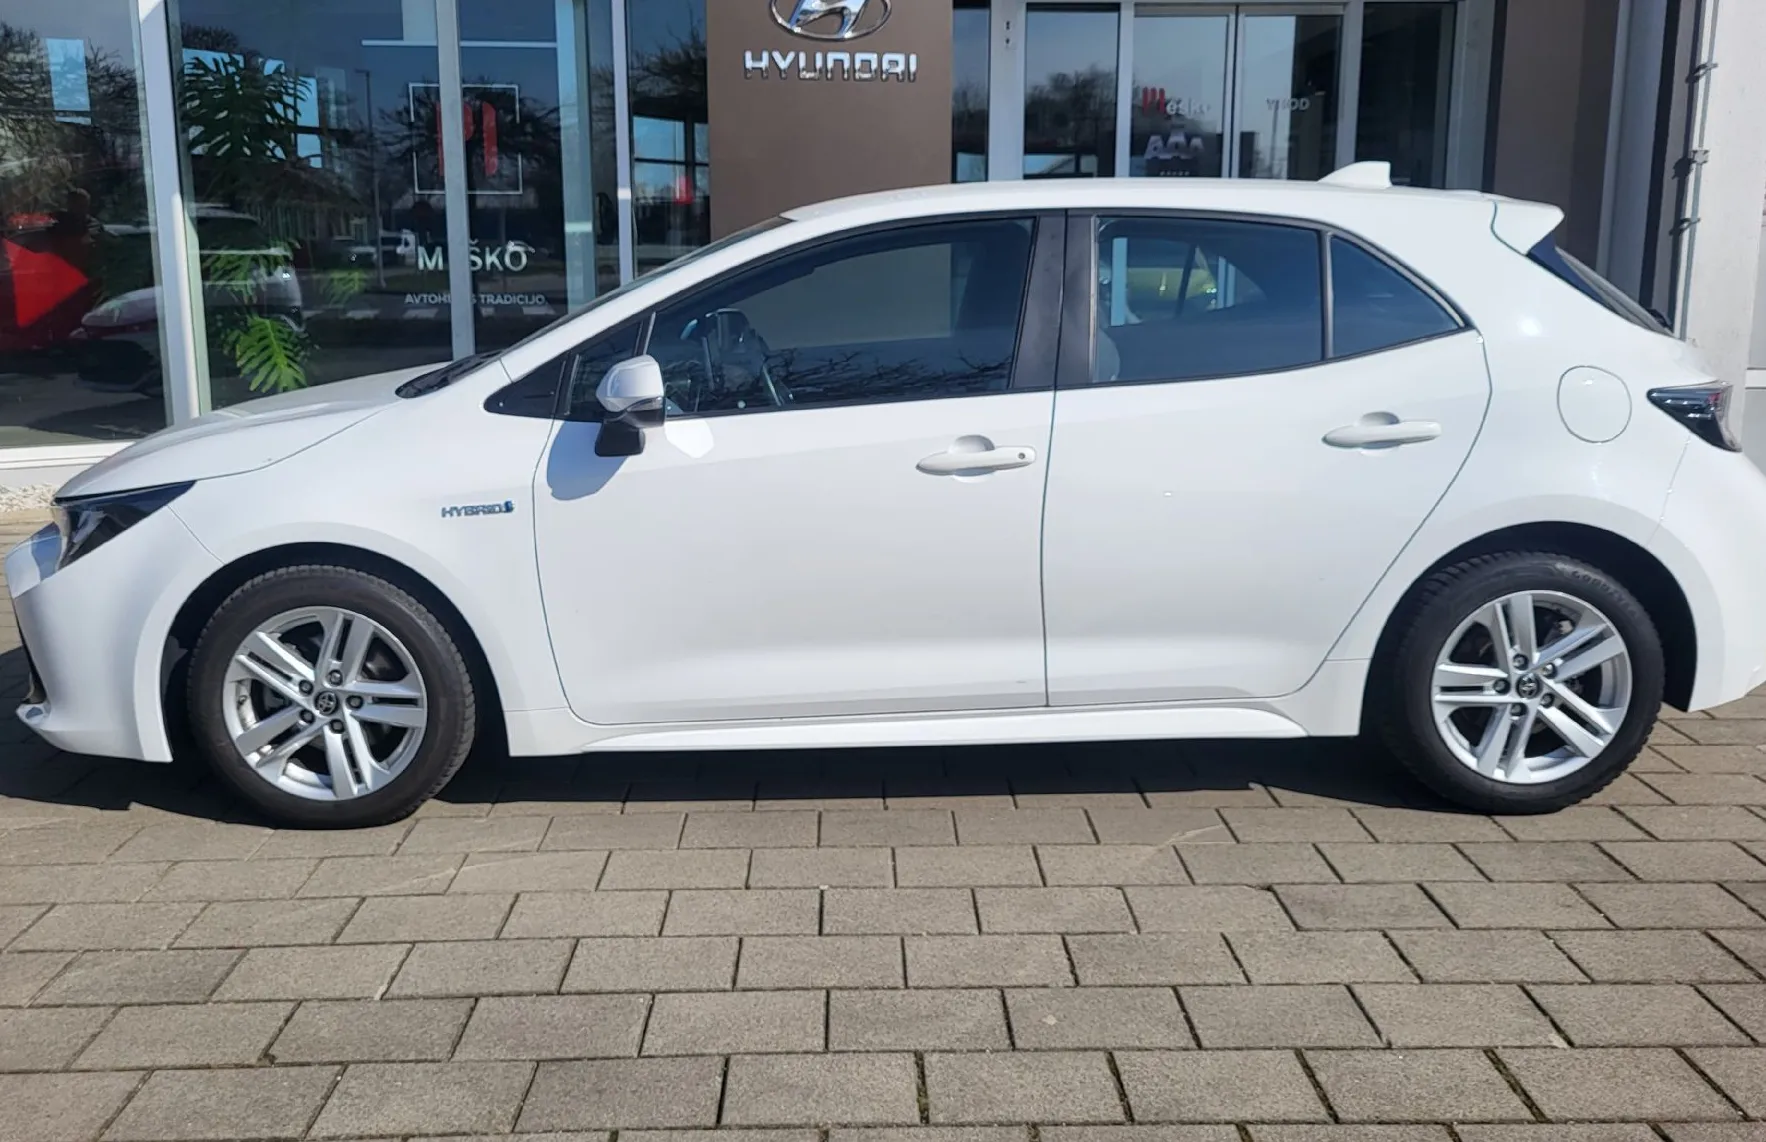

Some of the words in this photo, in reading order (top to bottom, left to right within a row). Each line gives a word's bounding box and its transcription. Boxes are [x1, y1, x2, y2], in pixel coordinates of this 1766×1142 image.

[744, 50, 918, 82] HYUNDAI
[417, 238, 529, 271] MŠKO
[441, 503, 502, 518] HYBRID
